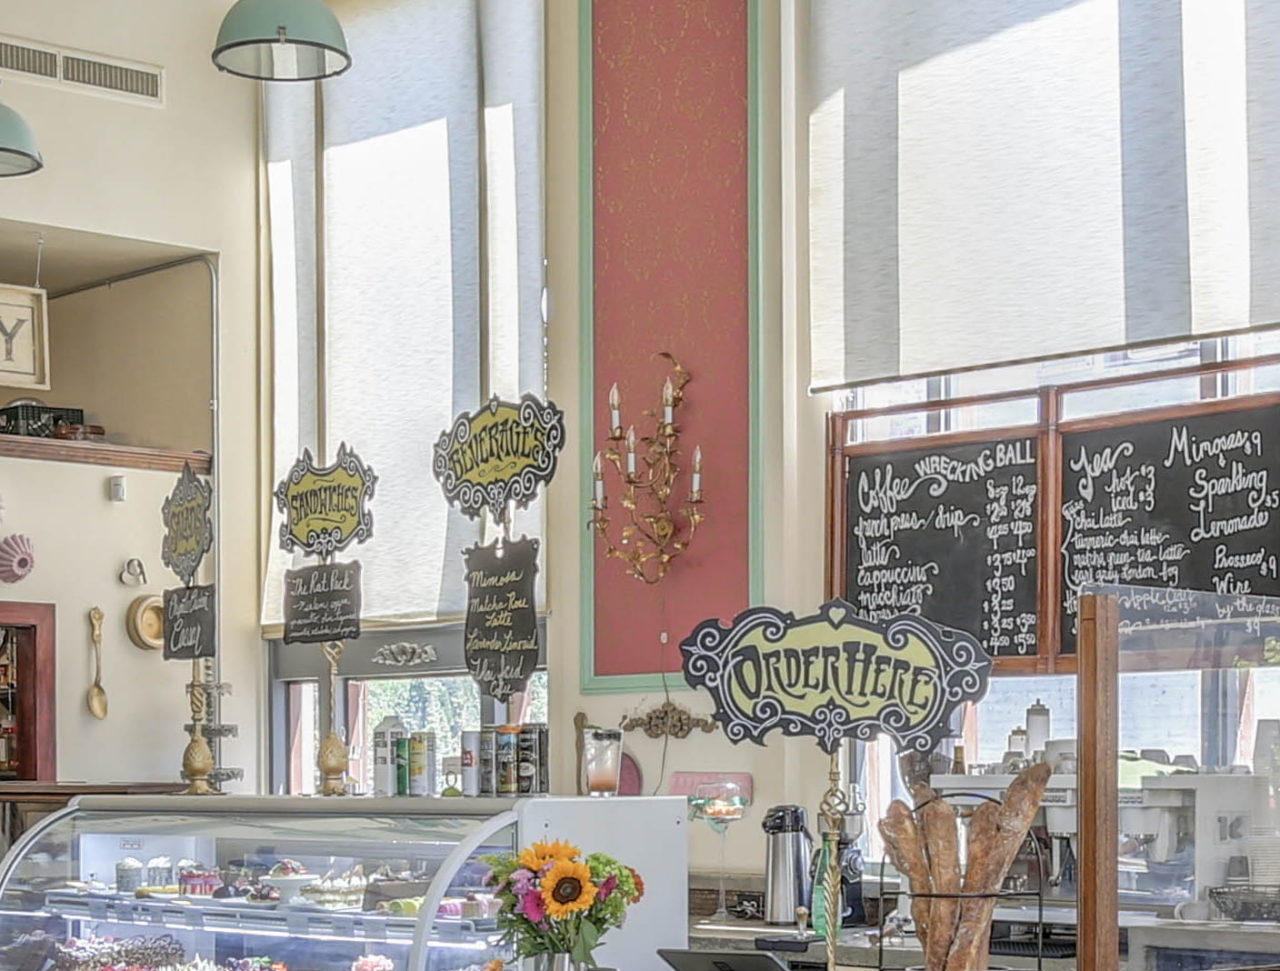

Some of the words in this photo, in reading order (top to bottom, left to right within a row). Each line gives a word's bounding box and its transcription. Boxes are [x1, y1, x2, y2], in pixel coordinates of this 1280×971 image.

[450, 418, 546, 480] BEVERAGES
[914, 450, 994, 482] WRECKING
[995, 440, 1036, 467] BALL
[858, 464, 948, 513] Coffee
[1070, 442, 1134, 502] Tea
[1104, 466, 1140, 493] hot
[1189, 461, 1267, 512] Sparkling
[1265, 490, 1280, 508] $5
[291, 484, 359, 526] SANDWICHES
[1100, 507, 1133, 529] latte
[1111, 490, 1139, 512] iced
[1189, 500, 1269, 542] Lemonade
[858, 560, 939, 593] cappuccino
[1158, 561, 1179, 586] fog
[1212, 572, 1252, 596] Wine
[858, 583, 934, 609] macchiato
[1215, 602, 1234, 621] by
[1233, 596, 1255, 612] the
[730, 645, 870, 708] ORDER
[841, 641, 939, 715] HERE
